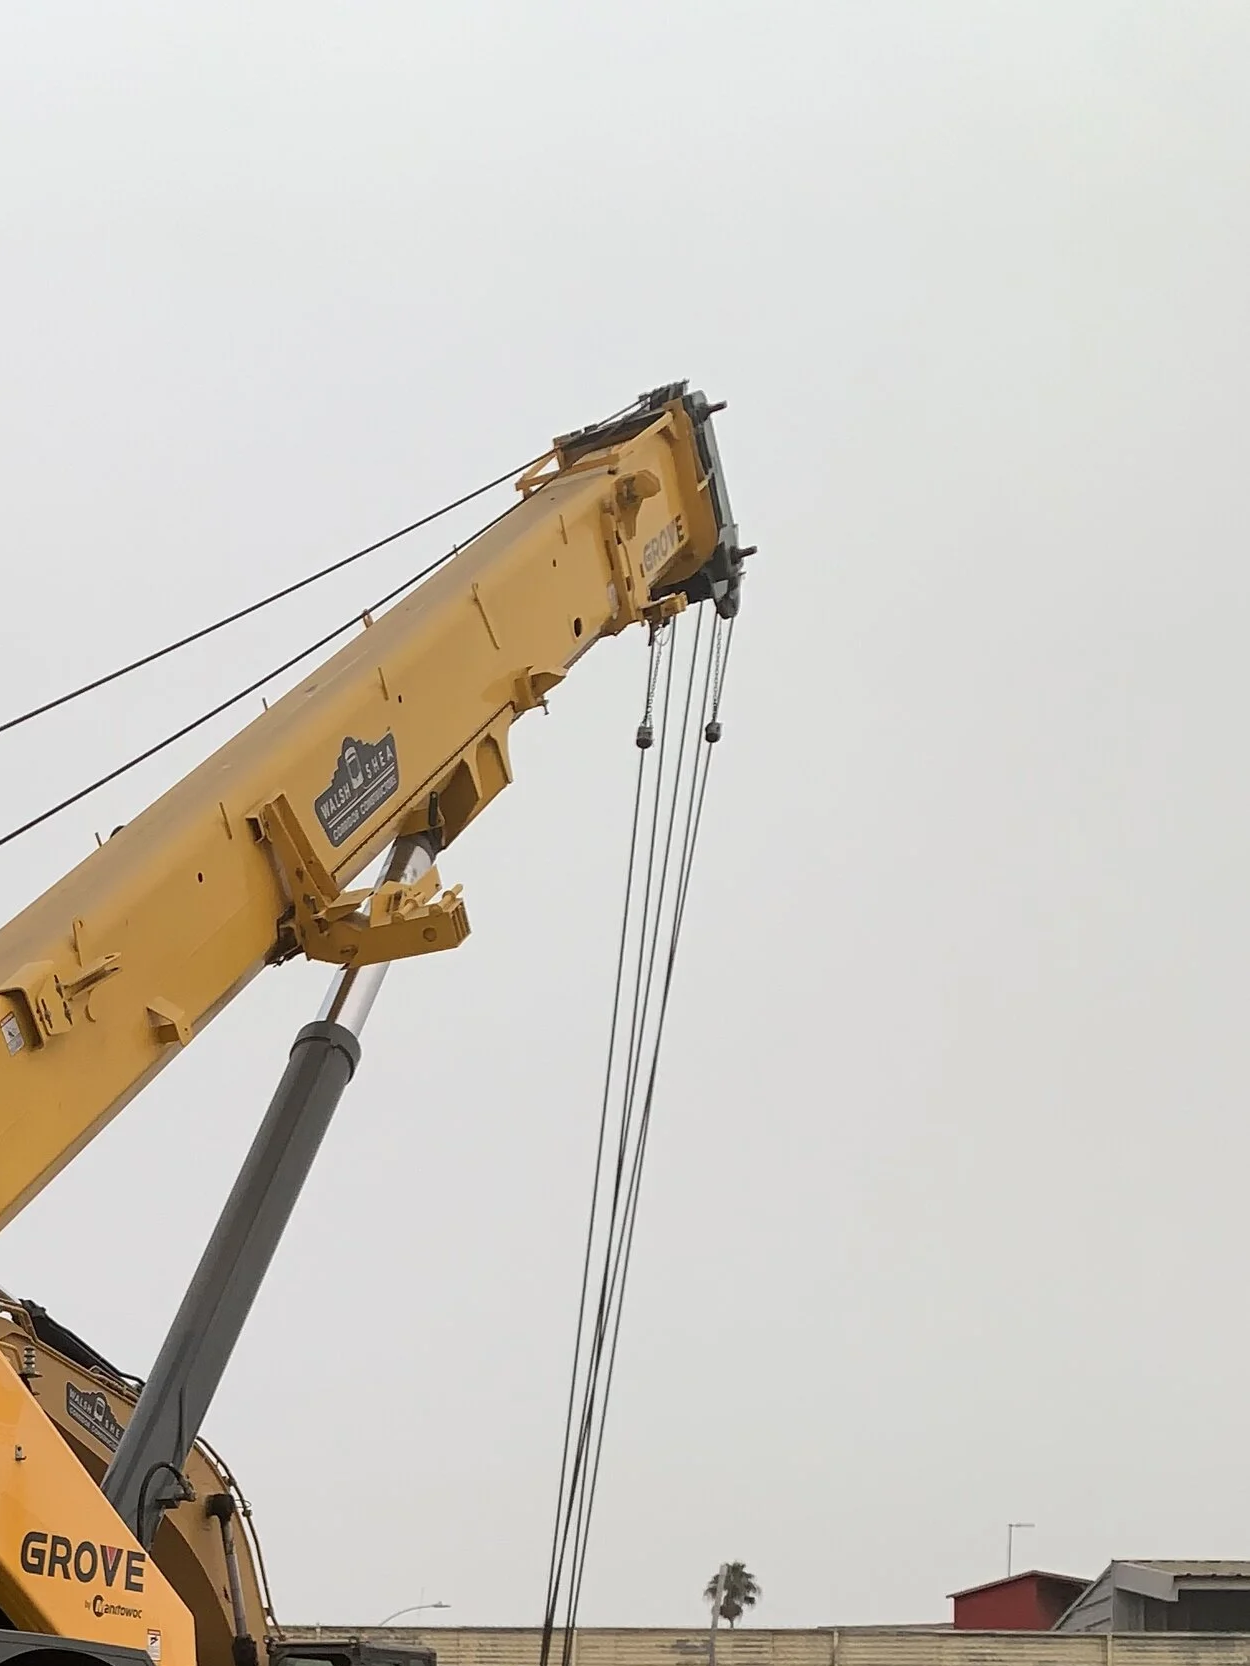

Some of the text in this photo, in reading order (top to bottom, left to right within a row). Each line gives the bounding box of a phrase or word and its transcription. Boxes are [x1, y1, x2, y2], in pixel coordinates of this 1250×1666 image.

[643, 514, 685, 573] GROVE
[320, 745, 394, 819] WALSH SHEA
[69, 1388, 93, 1415] WALSH
[20, 1531, 146, 1593] GROVE
[92, 1594, 143, 1619] Manitowoc
